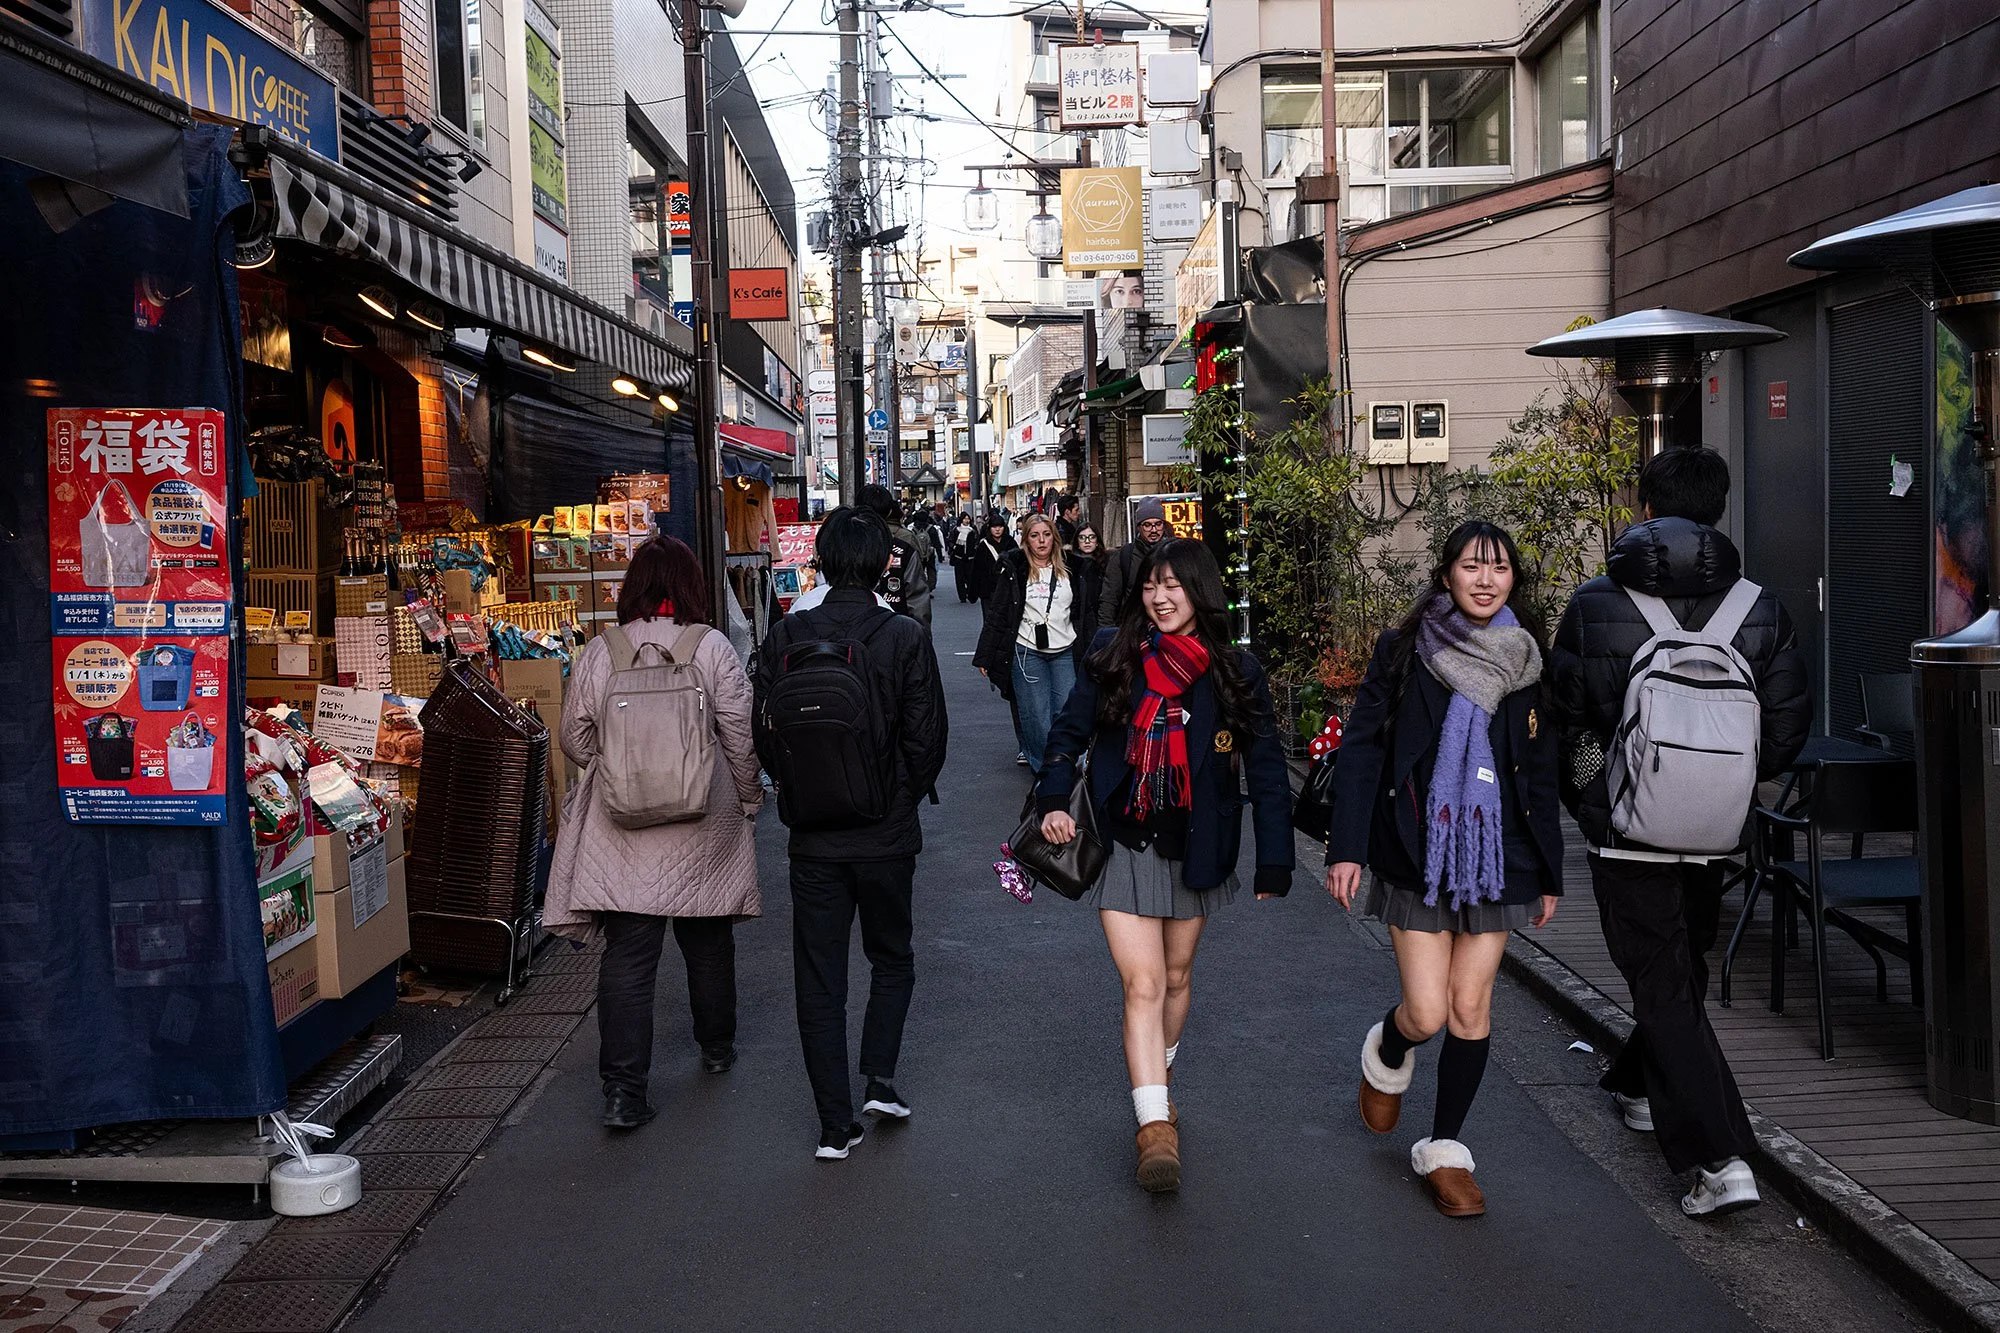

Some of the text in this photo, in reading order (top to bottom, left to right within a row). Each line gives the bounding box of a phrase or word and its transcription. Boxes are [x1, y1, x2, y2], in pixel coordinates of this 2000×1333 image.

[1066, 51, 1130, 60] リラクゼーション
[251, 66, 311, 134] COFFEE
[1065, 94, 1135, 110] 当ビル2階
[1085, 198, 1120, 208] aurum
[1085, 237, 1121, 247] hair&spa
[1070, 252, 1136, 263] tel 03-6407-9266
[733, 286, 783, 299] K's Café
[79, 418, 192, 475] 福袋
[201, 428, 214, 470] 新春発売
[152, 496, 204, 508] 食品福袋は
[155, 511, 202, 520] 公式アプリで
[56, 594, 110, 602] 食品福袋販売方法
[83, 647, 111, 655] 当店では
[67, 657, 126, 667] コーヒー福袋を
[75, 683, 117, 693] 店頭販売
[65, 789, 127, 797] コーヒー福袋販売方法
